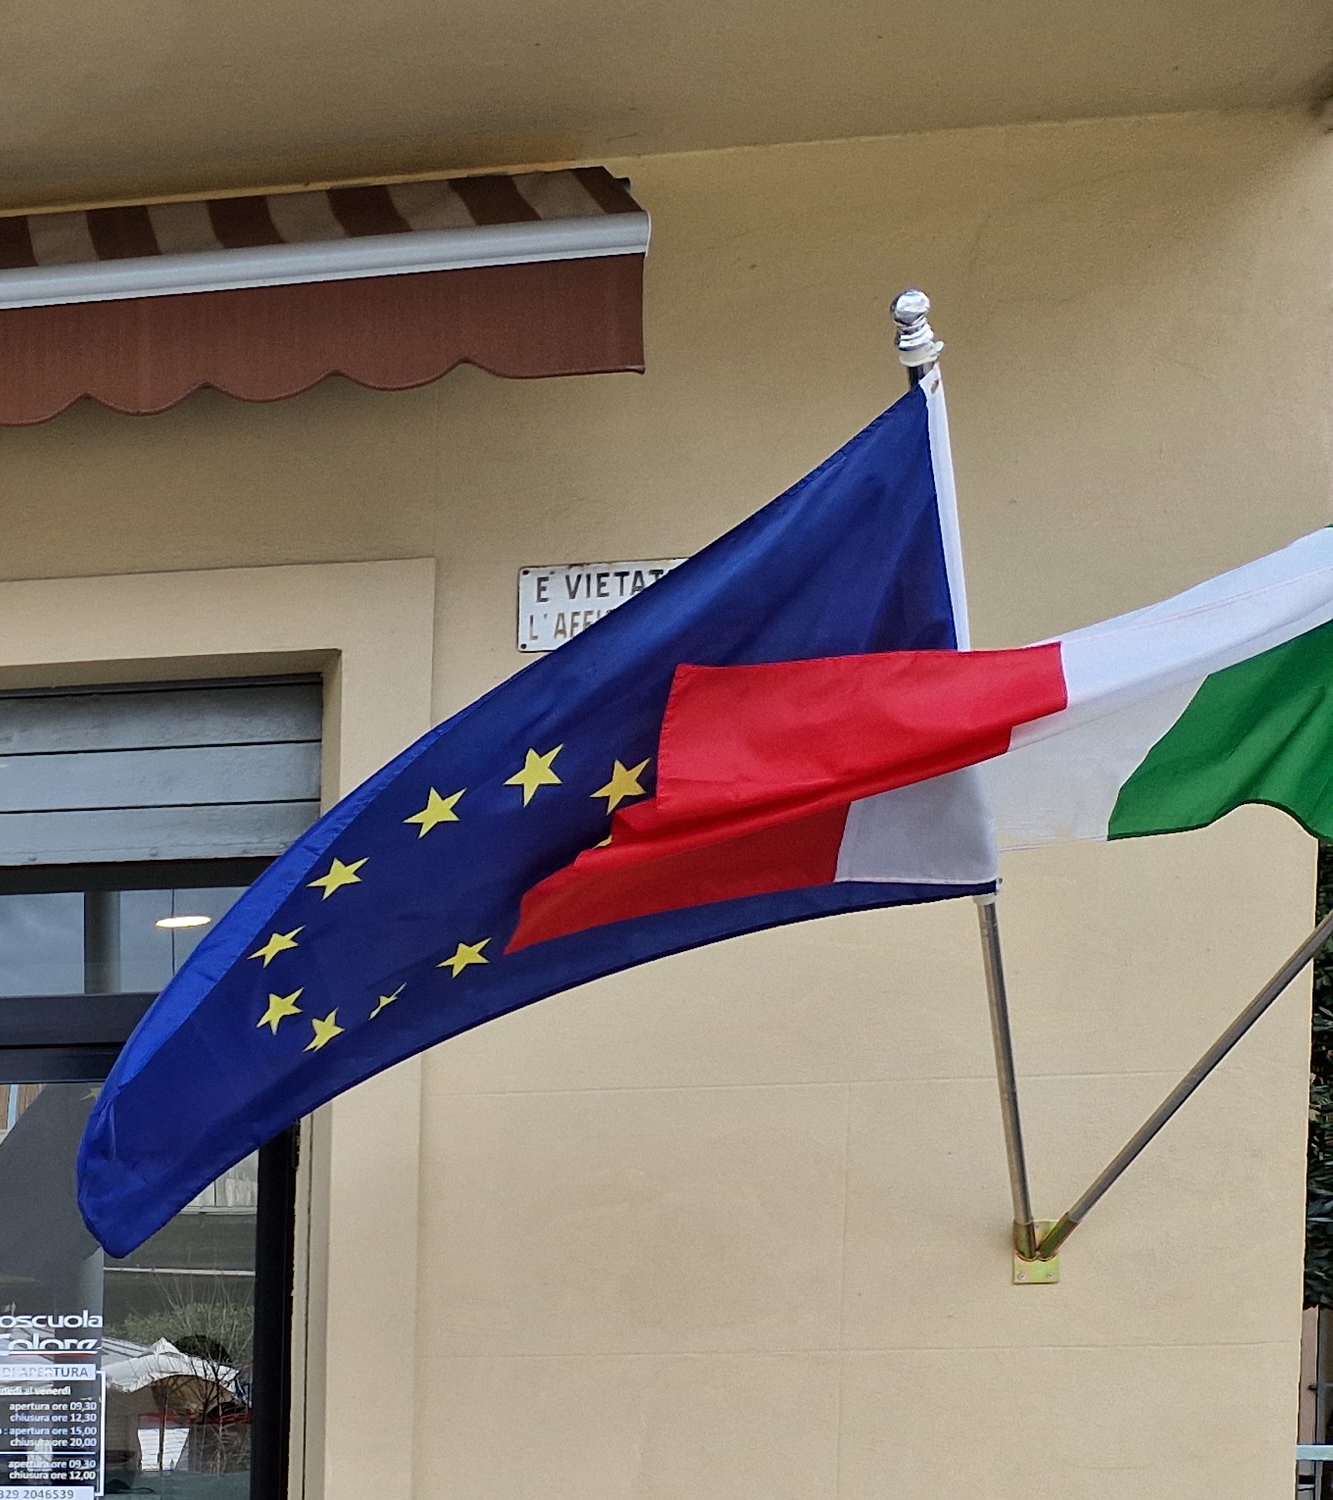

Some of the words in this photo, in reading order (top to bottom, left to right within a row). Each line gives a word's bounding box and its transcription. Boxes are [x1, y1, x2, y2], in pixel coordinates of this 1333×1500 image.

[565, 569, 670, 599] VIETAT
[21, 1367, 89, 1377] APERTURA
[9, 1402, 50, 1412] apertura
[52, 1403, 69, 1411] ore
[10, 1414, 50, 1423] chiusura
[52, 1415, 69, 1423] ore
[70, 1414, 97, 1423] 12,30
[9, 1427, 50, 1437] apertura
[52, 1428, 69, 1436] ore
[70, 1427, 97, 1436] 15,00
[52, 1439, 68, 1447] ore
[51, 1460, 67, 1468] ore
[9, 1471, 49, 1480] chiusura
[50, 1472, 67, 1480] ore
[69, 1471, 96, 1481] 12,00
